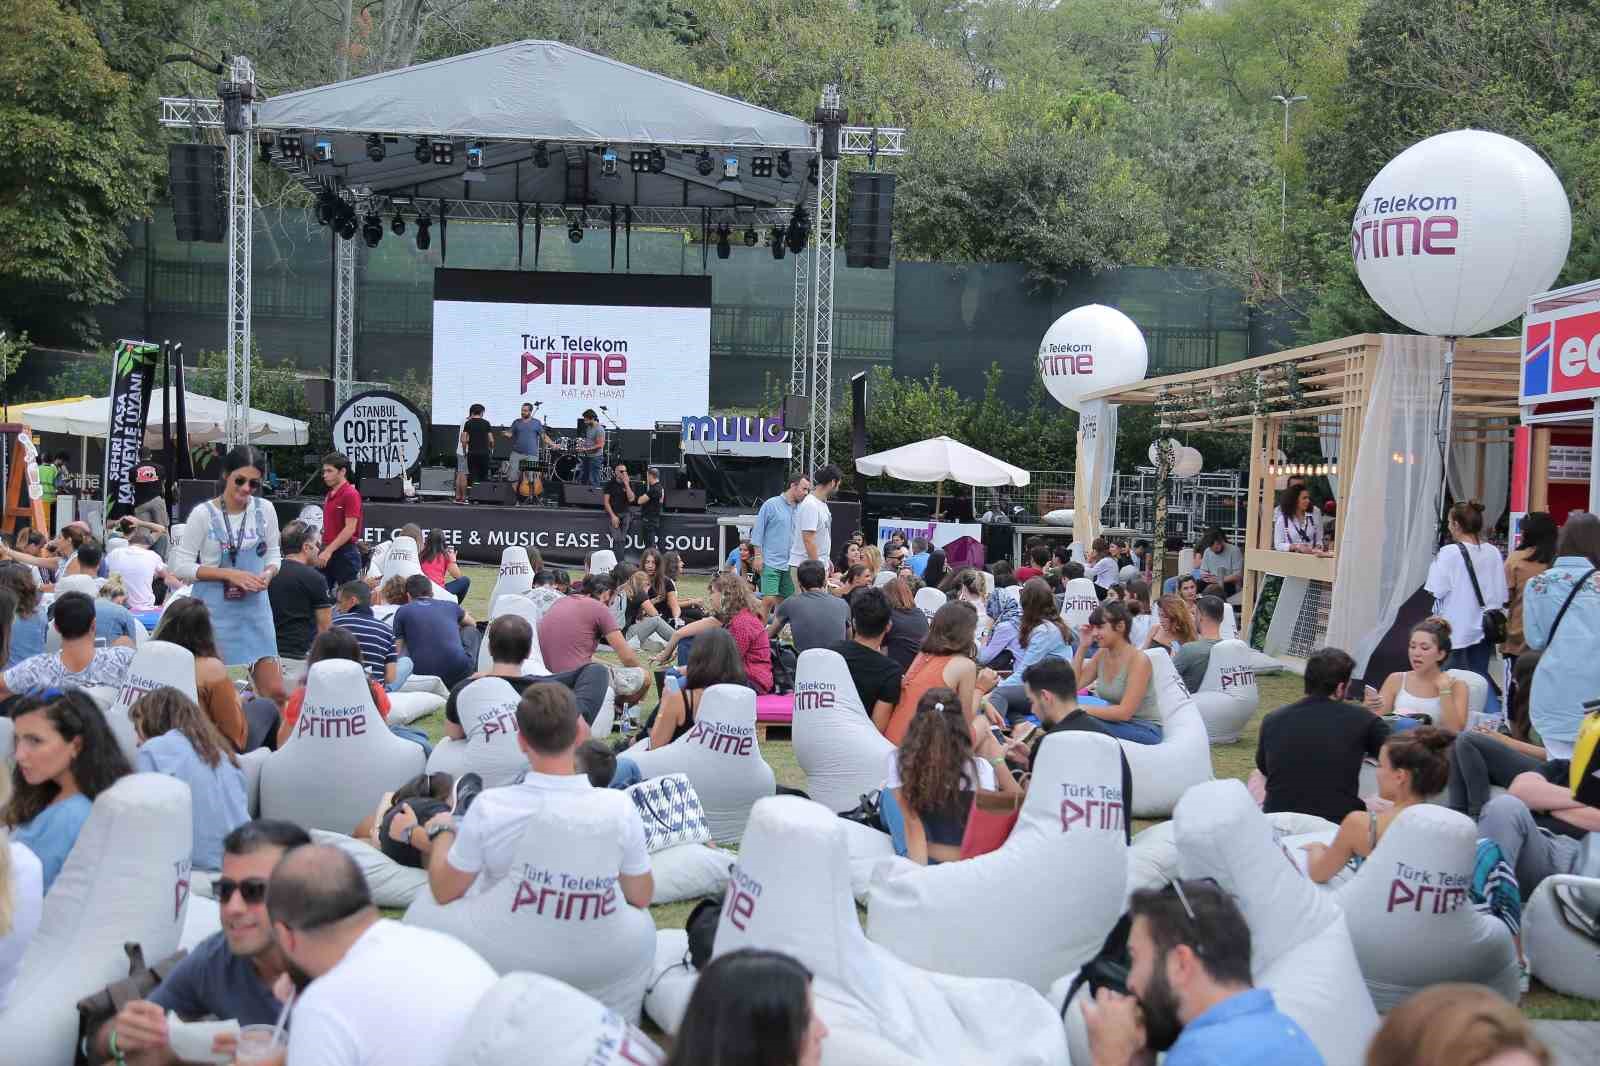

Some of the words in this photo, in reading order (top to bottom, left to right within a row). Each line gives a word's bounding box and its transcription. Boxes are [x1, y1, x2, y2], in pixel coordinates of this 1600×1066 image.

[1373, 194, 1457, 214] Telekom
[521, 334, 556, 351] Türk
[561, 335, 628, 352] Telekom
[1049, 343, 1092, 353] Telekom
[520, 352, 627, 395] prime
[343, 419, 409, 443] COFFEE
[469, 531, 482, 545] &
[487, 530, 549, 547] MUSIC
[555, 532, 600, 548] EASE
[665, 535, 715, 551] SOUL
[1221, 672, 1256, 690] prim
[298, 714, 366, 739] prime
[686, 720, 753, 756] prime
[1061, 783, 1094, 798] Türk
[1061, 799, 1123, 833] prim
[523, 863, 553, 886] Türk
[1396, 861, 1432, 885] Türk
[511, 880, 617, 920] prime
[1387, 879, 1467, 914] prim
